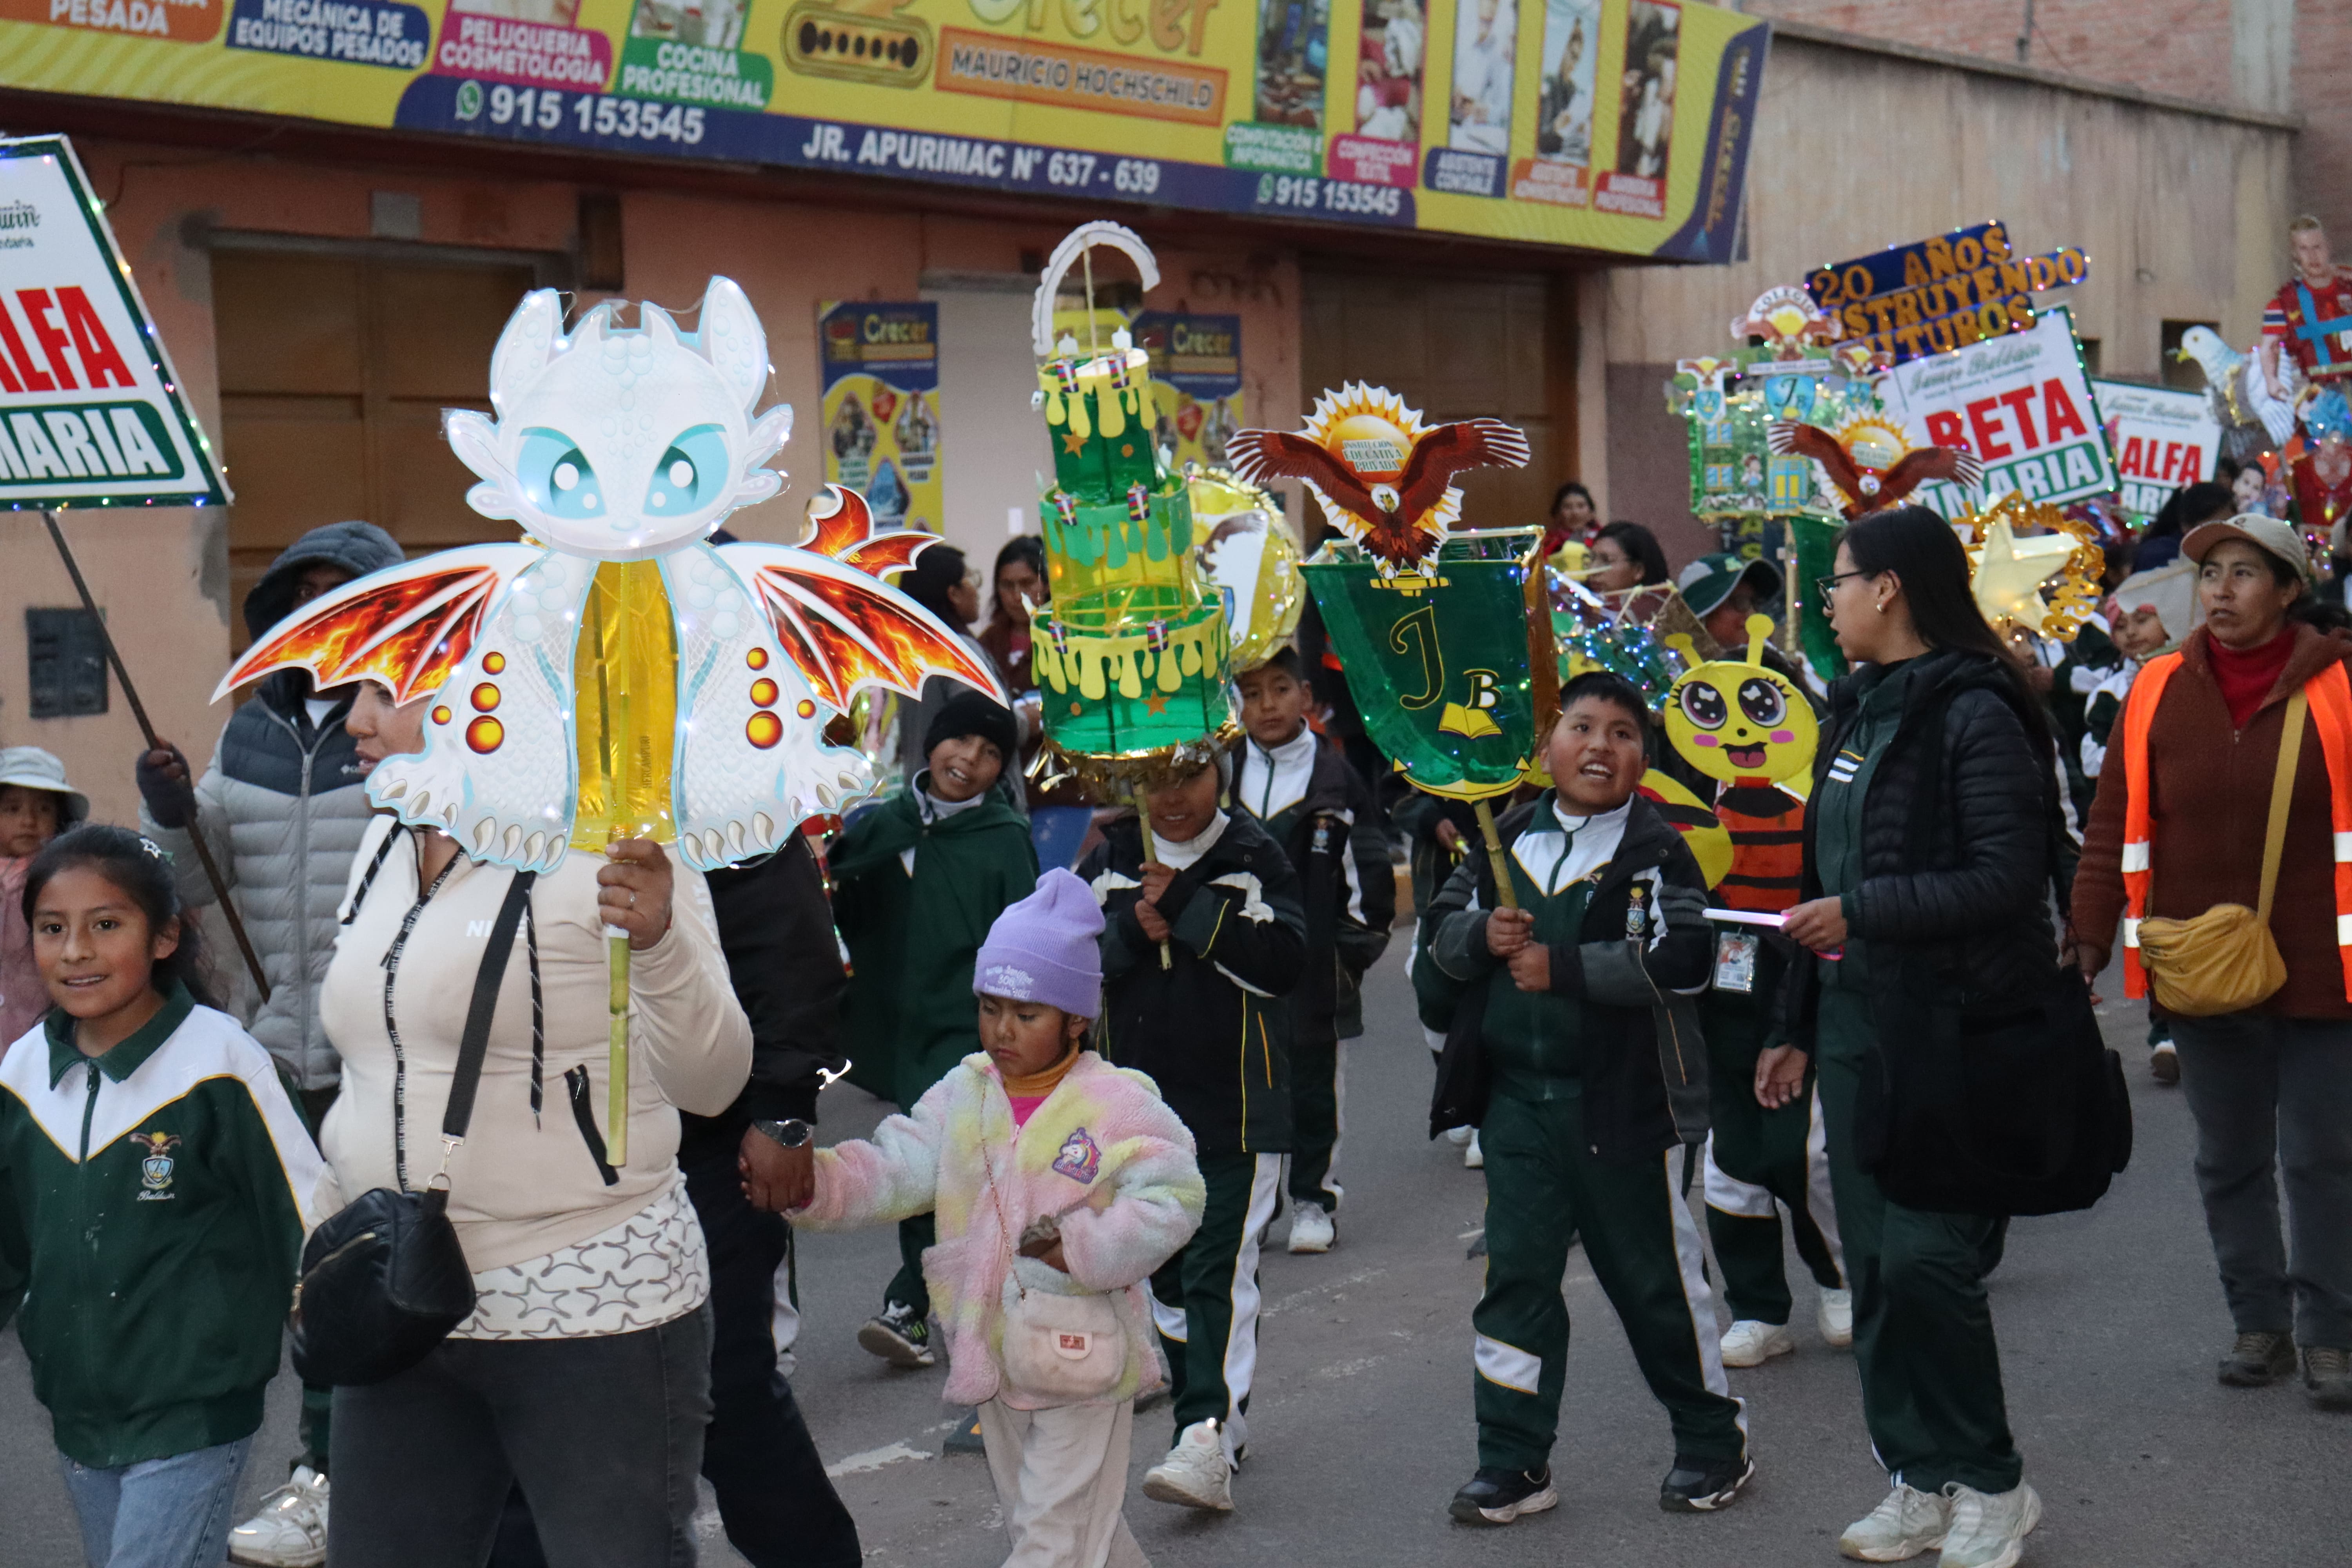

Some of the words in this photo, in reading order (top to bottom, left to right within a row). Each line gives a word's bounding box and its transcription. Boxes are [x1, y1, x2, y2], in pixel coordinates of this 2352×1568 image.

[50, 0, 169, 36] PESADA
[377, 9, 405, 38] DE
[236, 17, 328, 55] EQUIPOS
[332, 31, 424, 66] PESADOS
[657, 42, 739, 76] COCINA
[623, 65, 765, 107] PROFESIONAL
[950, 42, 1069, 91] MAURICIO
[1075, 61, 1214, 111] HOCHSCHILD
[490, 84, 563, 130] 915
[574, 94, 705, 145] 153545
[803, 123, 850, 162] JR.
[857, 129, 1005, 177] APURIMAC
[1047, 151, 1096, 187] 637
[1114, 158, 1160, 195] 639
[1275, 174, 1319, 208] 915
[1323, 179, 1401, 216] 153545
[1812, 264, 1874, 307] 20
[1904, 226, 2013, 287] AÑOS
[1754, 287, 1816, 315] COLEGIO
[0, 285, 138, 393] LFA
[1925, 377, 2089, 463] BETA
[1343, 449, 1404, 459] EDUCATIVA
[1354, 460, 1399, 470] PRIVADA
[2119, 436, 2202, 484] ALFA
[1389, 605, 1445, 710] J
[1463, 668, 1503, 710] B
[466, 920, 526, 938] NIE
